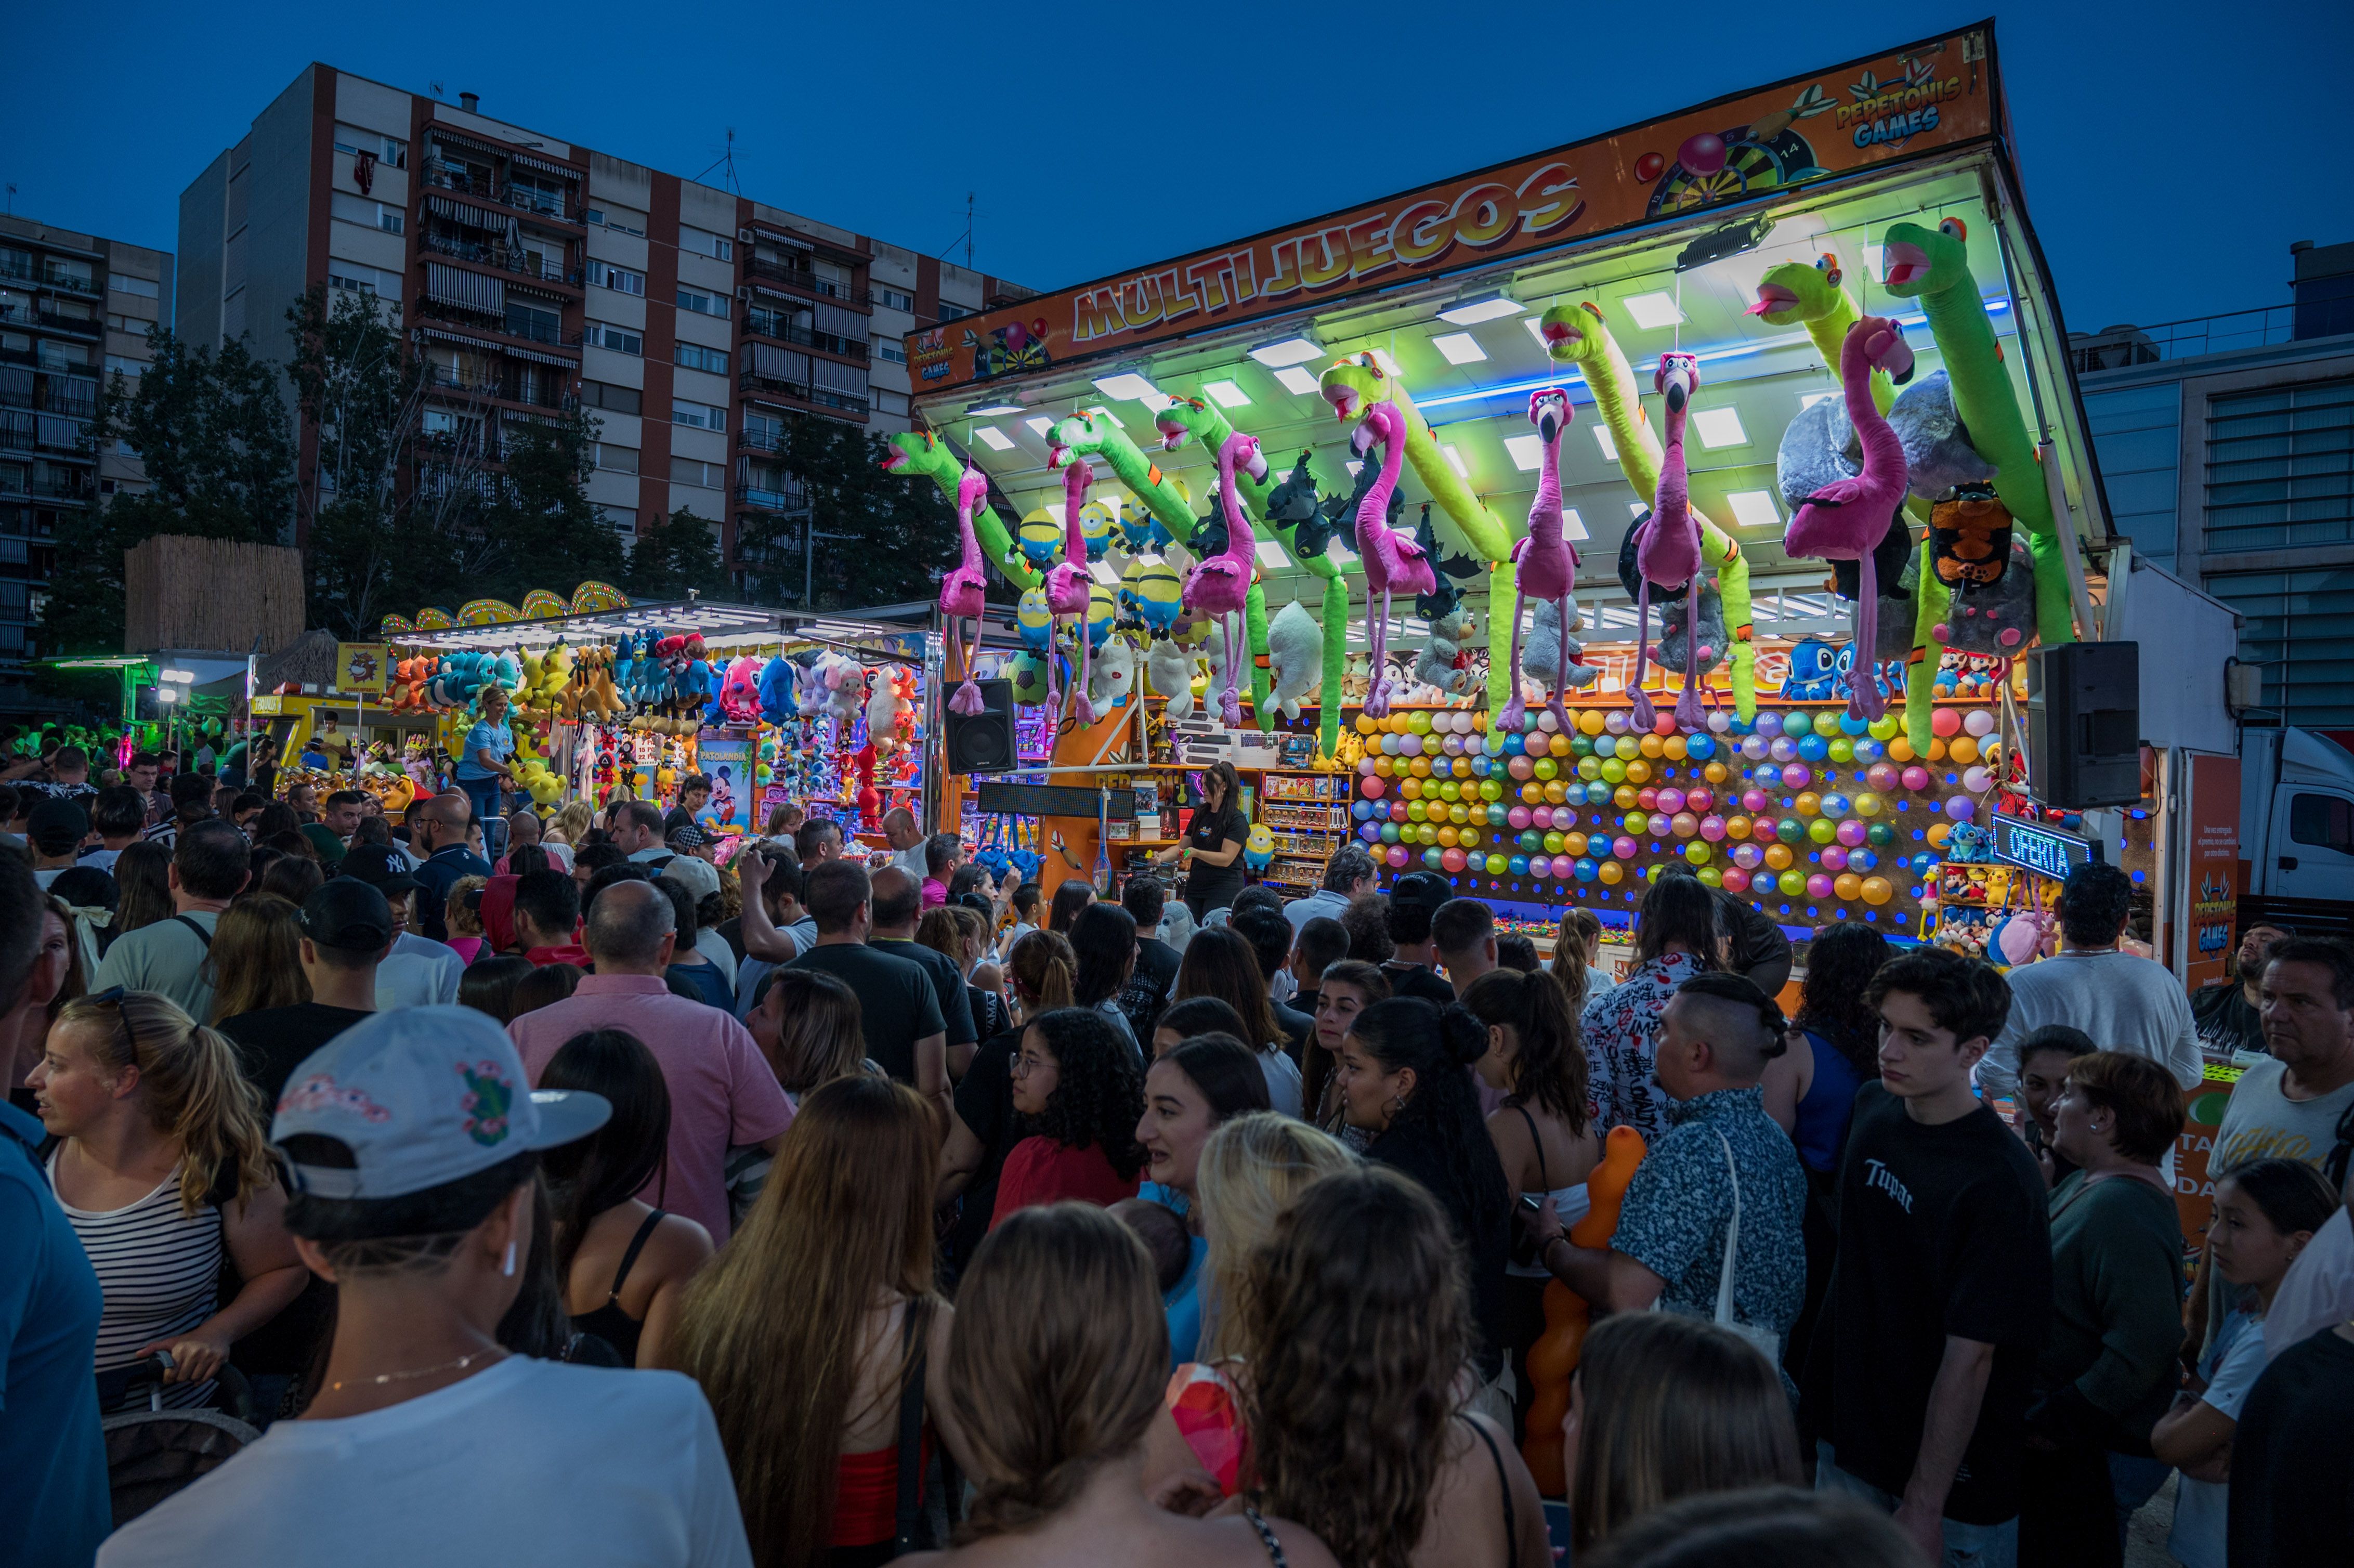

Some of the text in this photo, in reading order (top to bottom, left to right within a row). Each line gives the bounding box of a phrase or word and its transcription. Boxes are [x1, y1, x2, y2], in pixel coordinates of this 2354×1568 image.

[1836, 76, 1962, 130] PEPETONIS
[1853, 106, 1940, 148] GAMES
[1780, 142, 1800, 159] 14
[921, 361, 951, 381] GAMES
[700, 750, 747, 762] PATOLANDIA
[386, 854, 406, 873] NY
[2009, 826, 2070, 876] OFERTA
[2194, 899, 2237, 927] PEPETONIS
[2199, 924, 2228, 952] GAMES
[1864, 1158, 1914, 1215] Tupac
